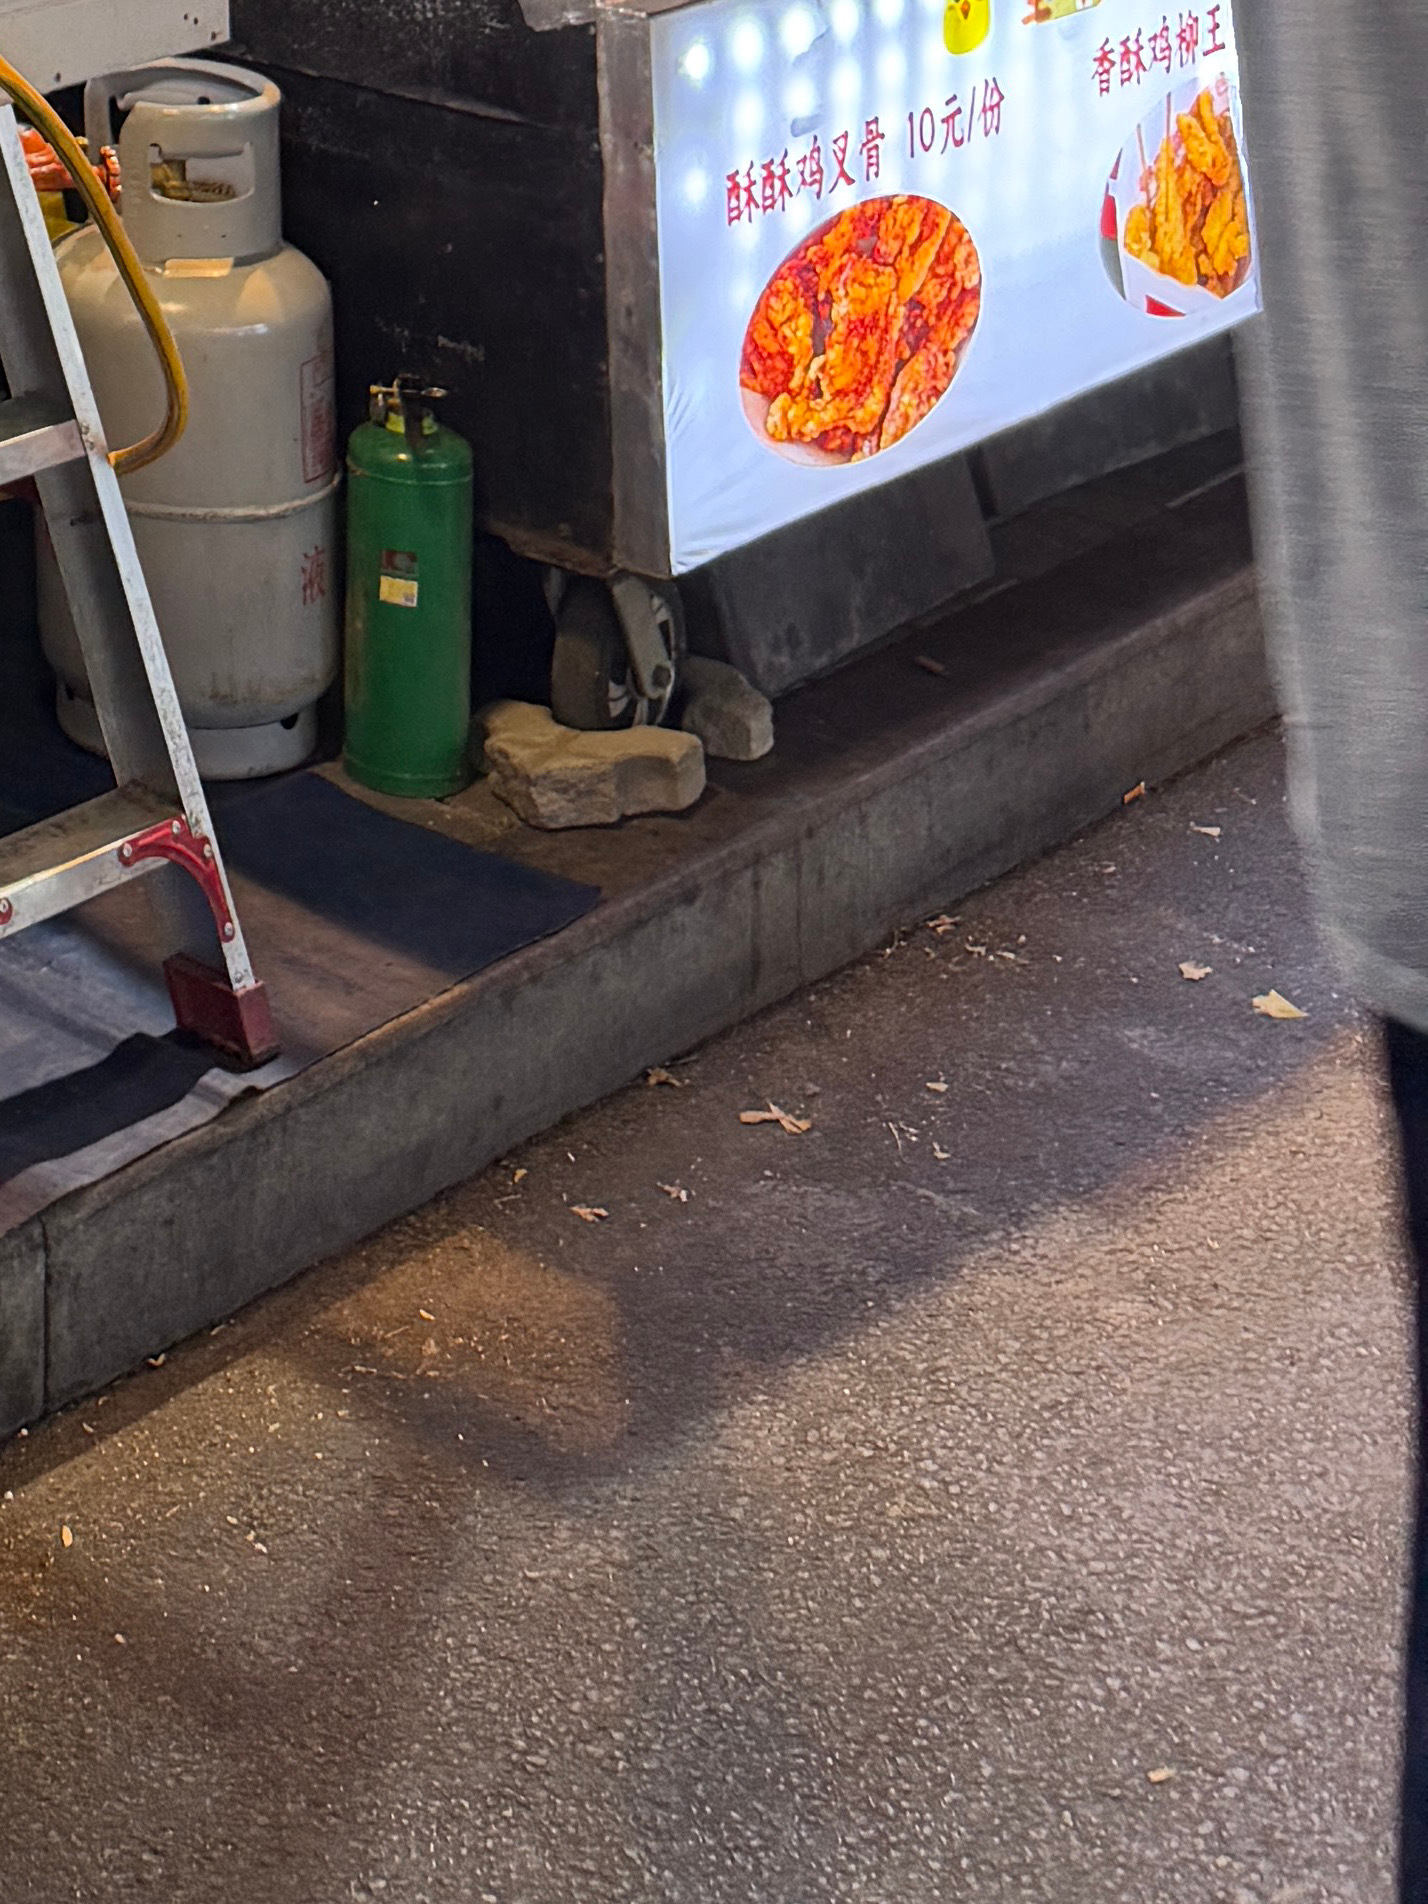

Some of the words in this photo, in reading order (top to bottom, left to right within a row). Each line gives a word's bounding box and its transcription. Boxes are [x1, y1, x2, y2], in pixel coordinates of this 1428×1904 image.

[1091, 4, 1227, 98] 香酥鸡柳王
[724, 115, 886, 227] 酥酥鸡叉骨
[907, 76, 1005, 159] 10元/份
